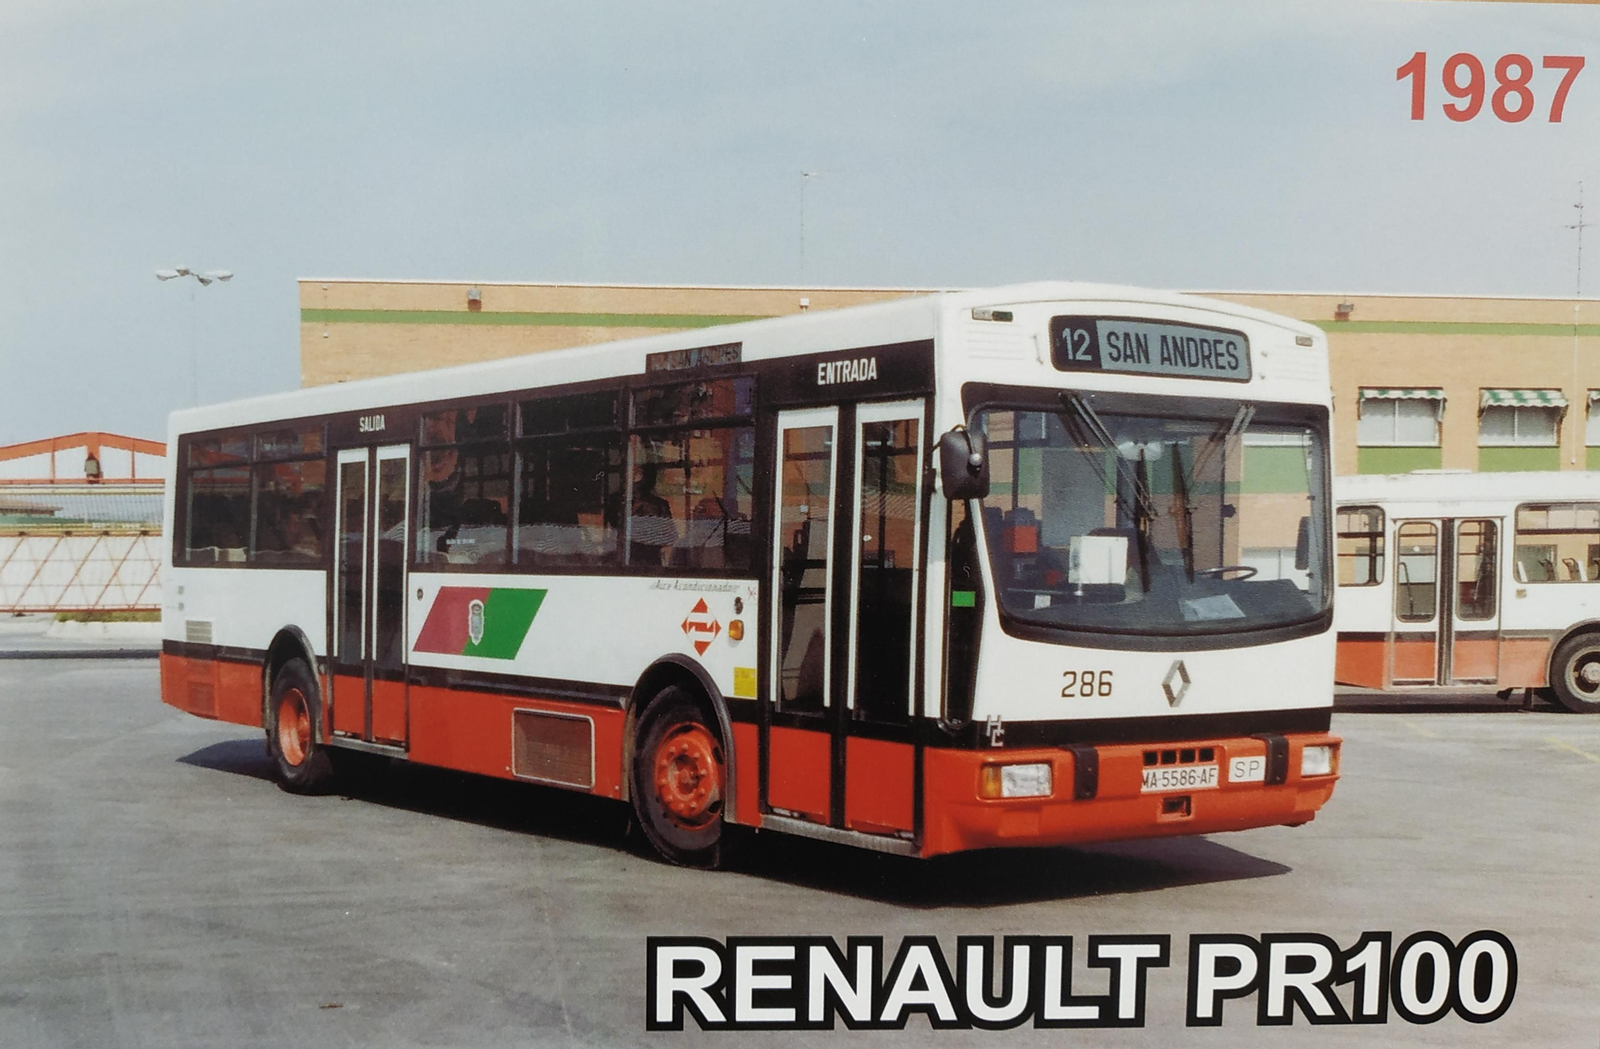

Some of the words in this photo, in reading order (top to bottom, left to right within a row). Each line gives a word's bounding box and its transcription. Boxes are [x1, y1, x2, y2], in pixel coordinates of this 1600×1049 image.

[1062, 327, 1092, 361] 12
[1106, 331, 1150, 364] SAN
[1159, 335, 1240, 371] ANDRES
[817, 357, 878, 386] ENTRADA
[359, 414, 386, 433] SALIDA
[1061, 670, 1113, 698] 286
[1234, 760, 1260, 778] SP
